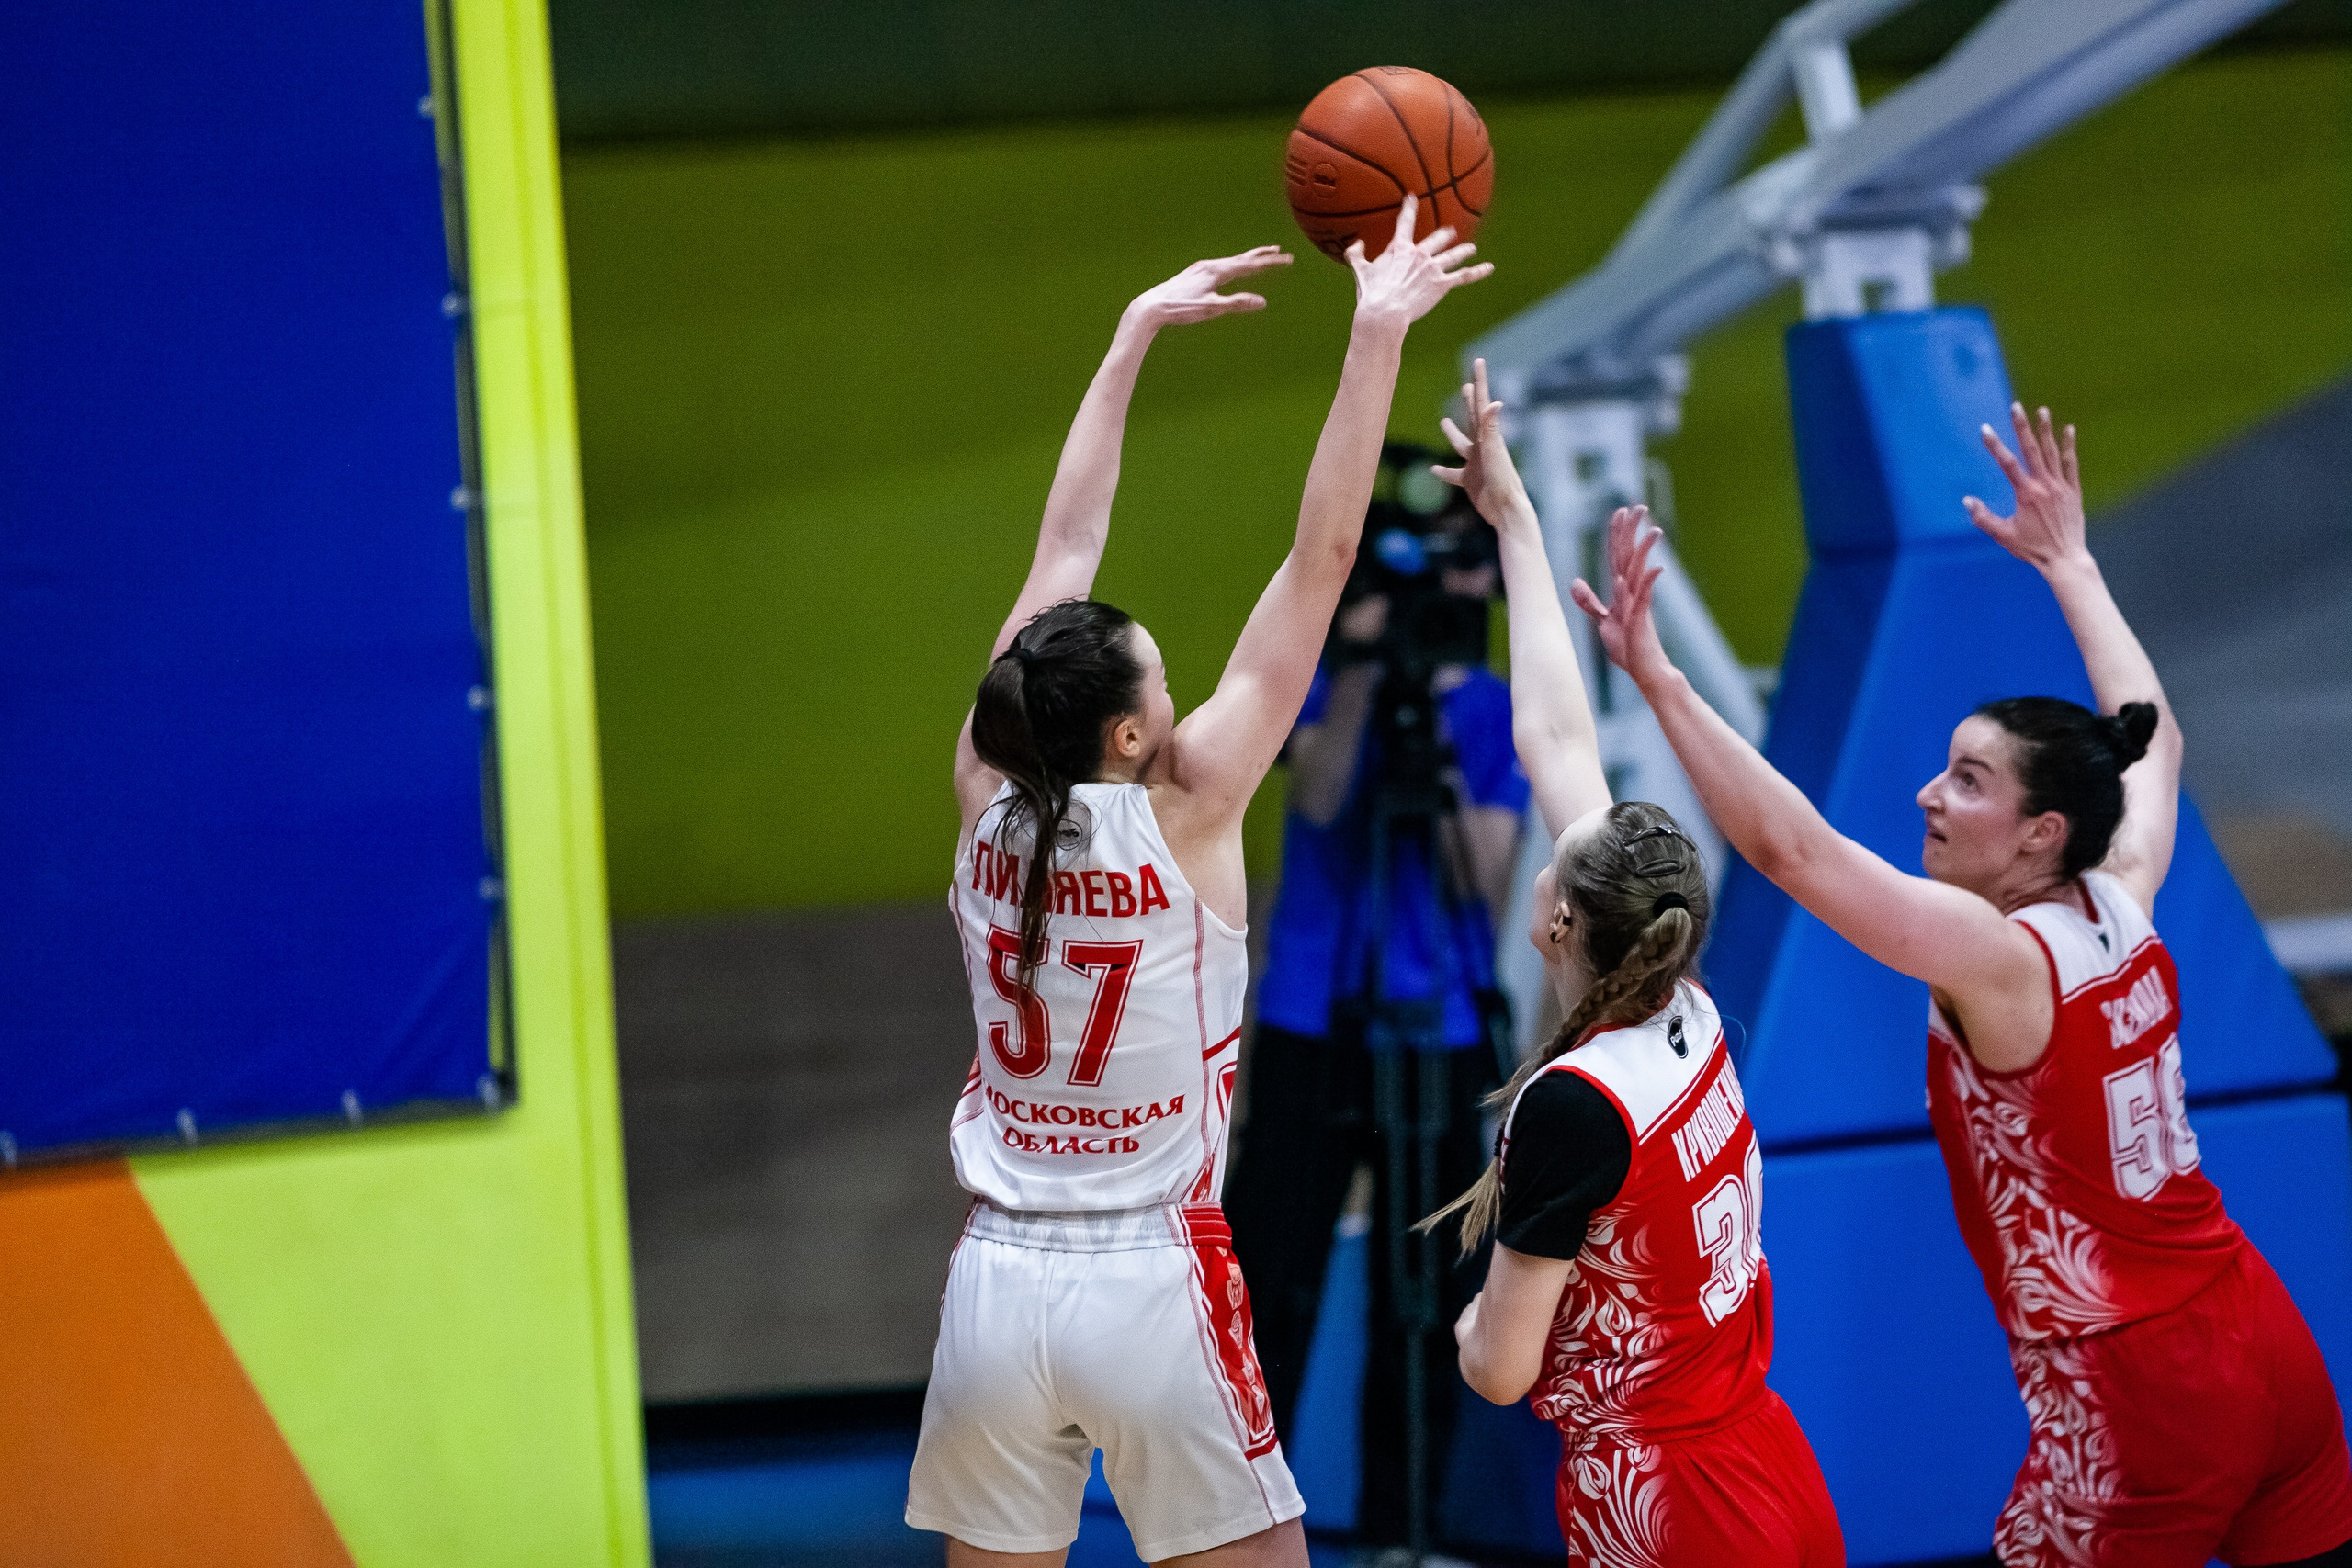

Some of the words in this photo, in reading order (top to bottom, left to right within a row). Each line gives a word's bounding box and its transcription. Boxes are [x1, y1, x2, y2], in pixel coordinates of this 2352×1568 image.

[972, 840, 1170, 918] ПИЯЕВА
[986, 922, 1144, 1088] 57
[1002, 1126, 1140, 1155] ОБЛАСТЬ
